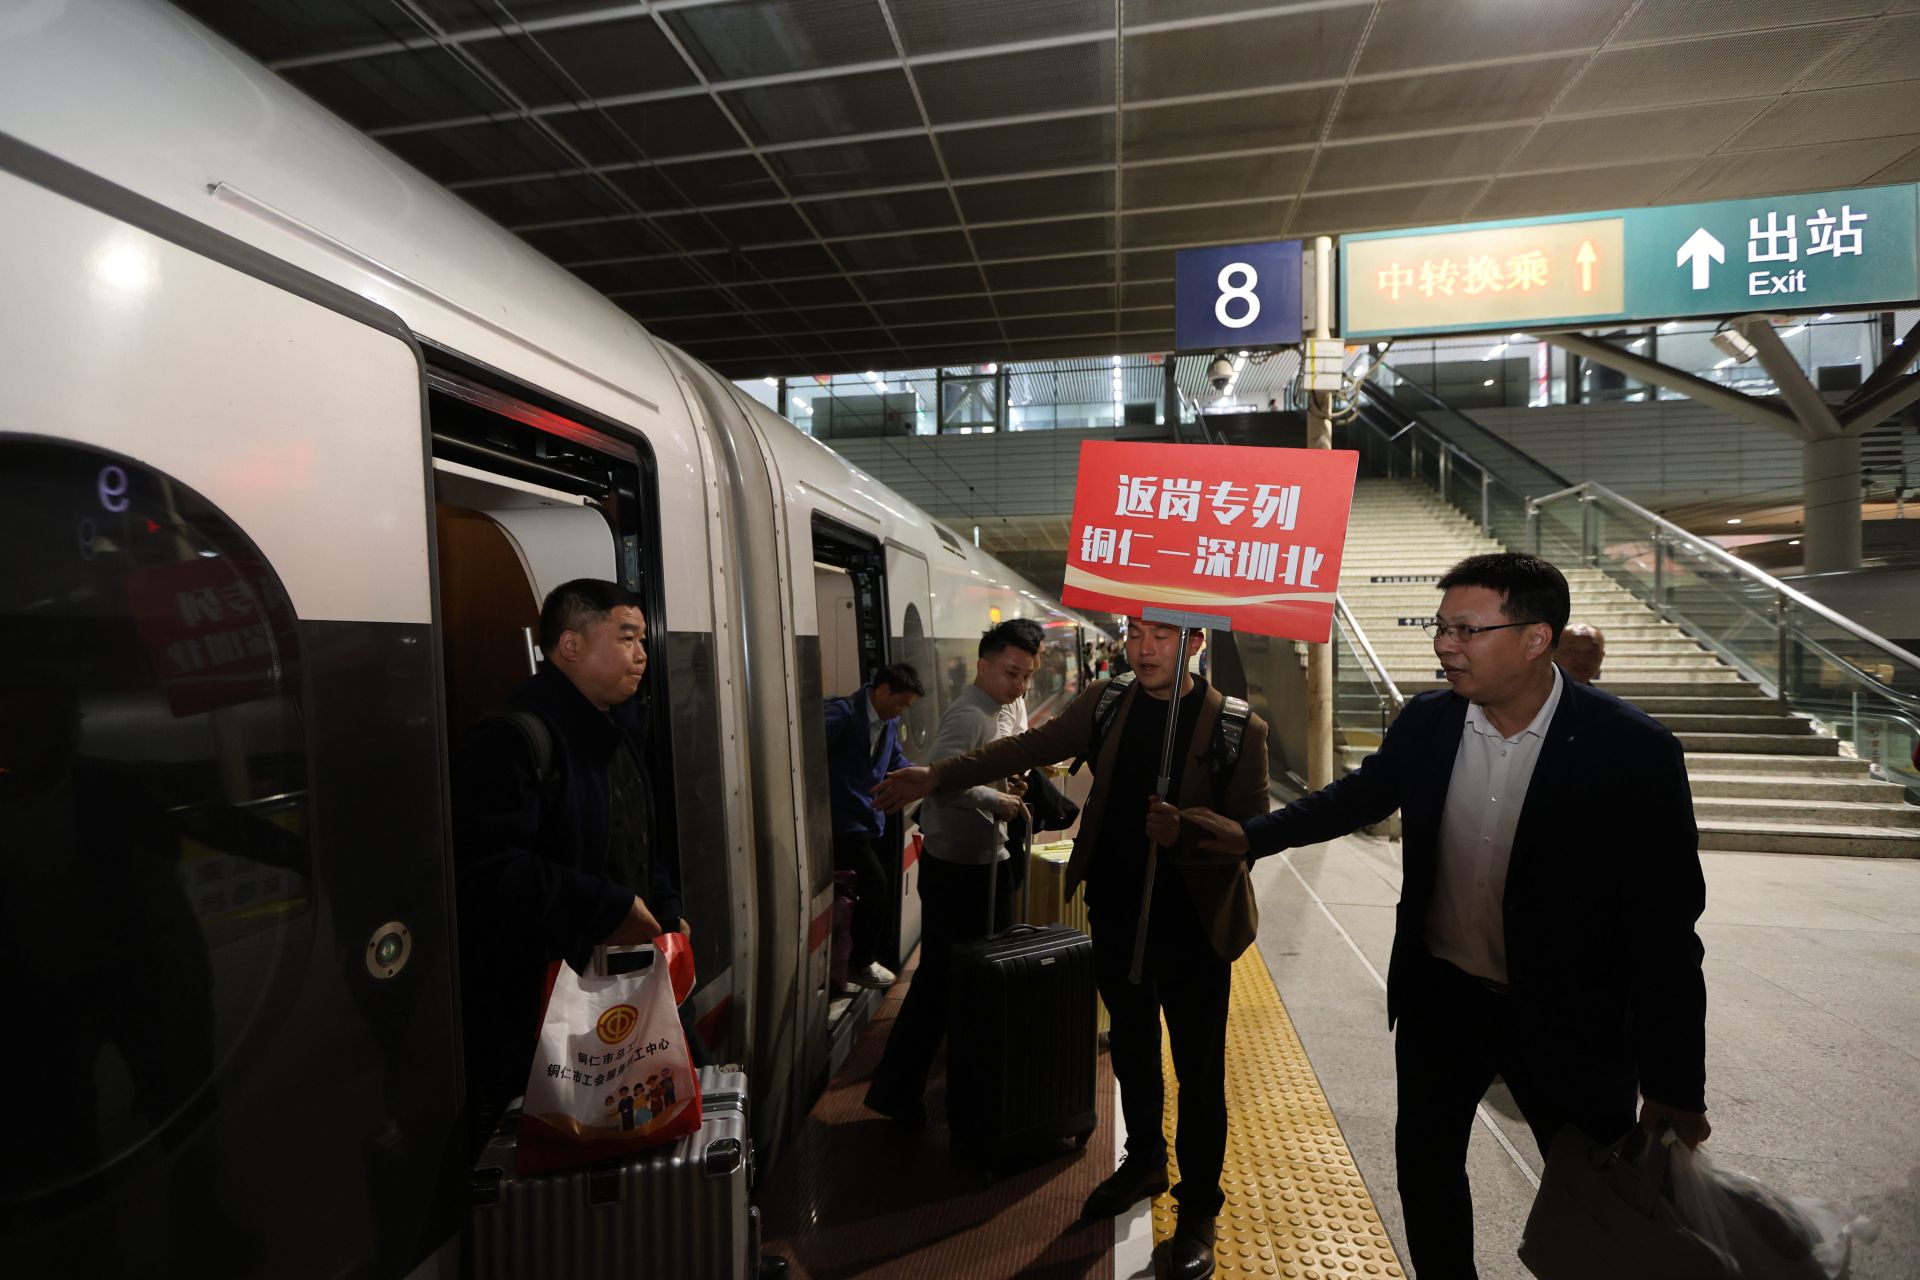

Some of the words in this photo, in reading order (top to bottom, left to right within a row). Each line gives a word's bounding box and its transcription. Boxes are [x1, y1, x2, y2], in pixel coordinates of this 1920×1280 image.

[1748, 205, 1868, 263] 出站
[1215, 262, 1261, 329] 8
[1378, 250, 1549, 300] 中转换乘
[1749, 269, 1807, 296] Exit
[1115, 474, 1301, 531] 返岗专列
